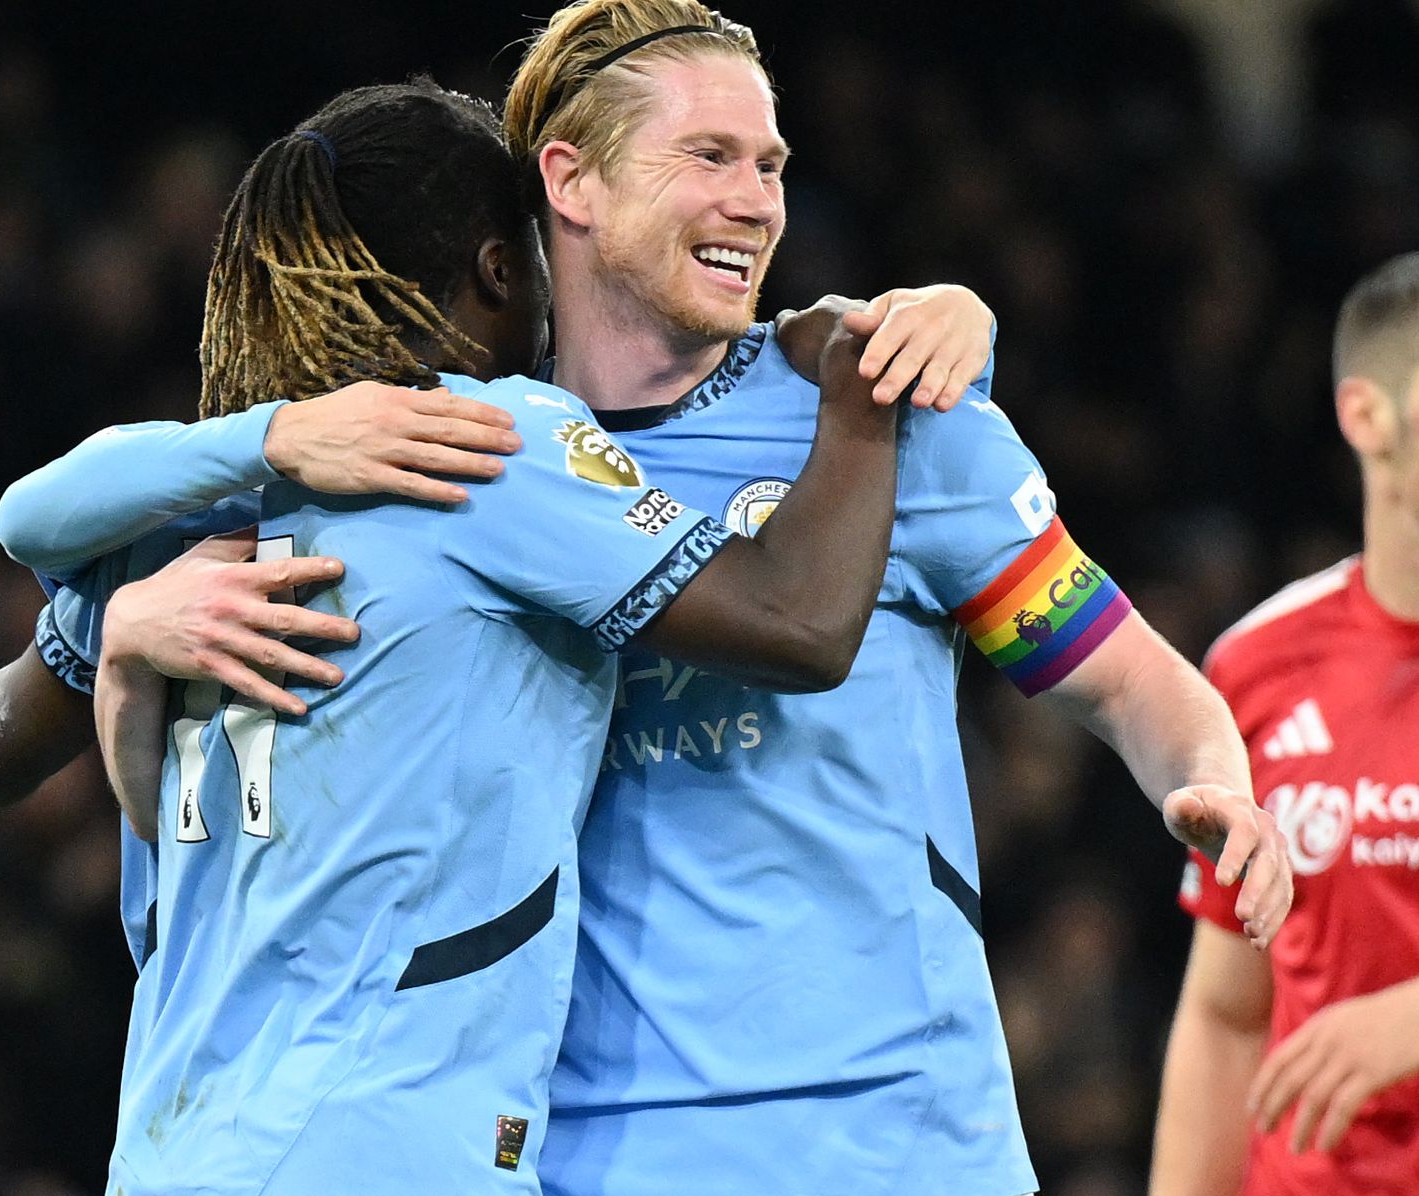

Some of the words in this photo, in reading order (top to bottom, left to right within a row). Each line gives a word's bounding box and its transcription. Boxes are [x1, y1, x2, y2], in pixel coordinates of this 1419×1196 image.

[621, 504, 652, 528] No
[647, 490, 669, 510] ro
[659, 501, 686, 522] ra
[733, 484, 789, 511] MANCHES
[1048, 558, 1105, 609] Cap
